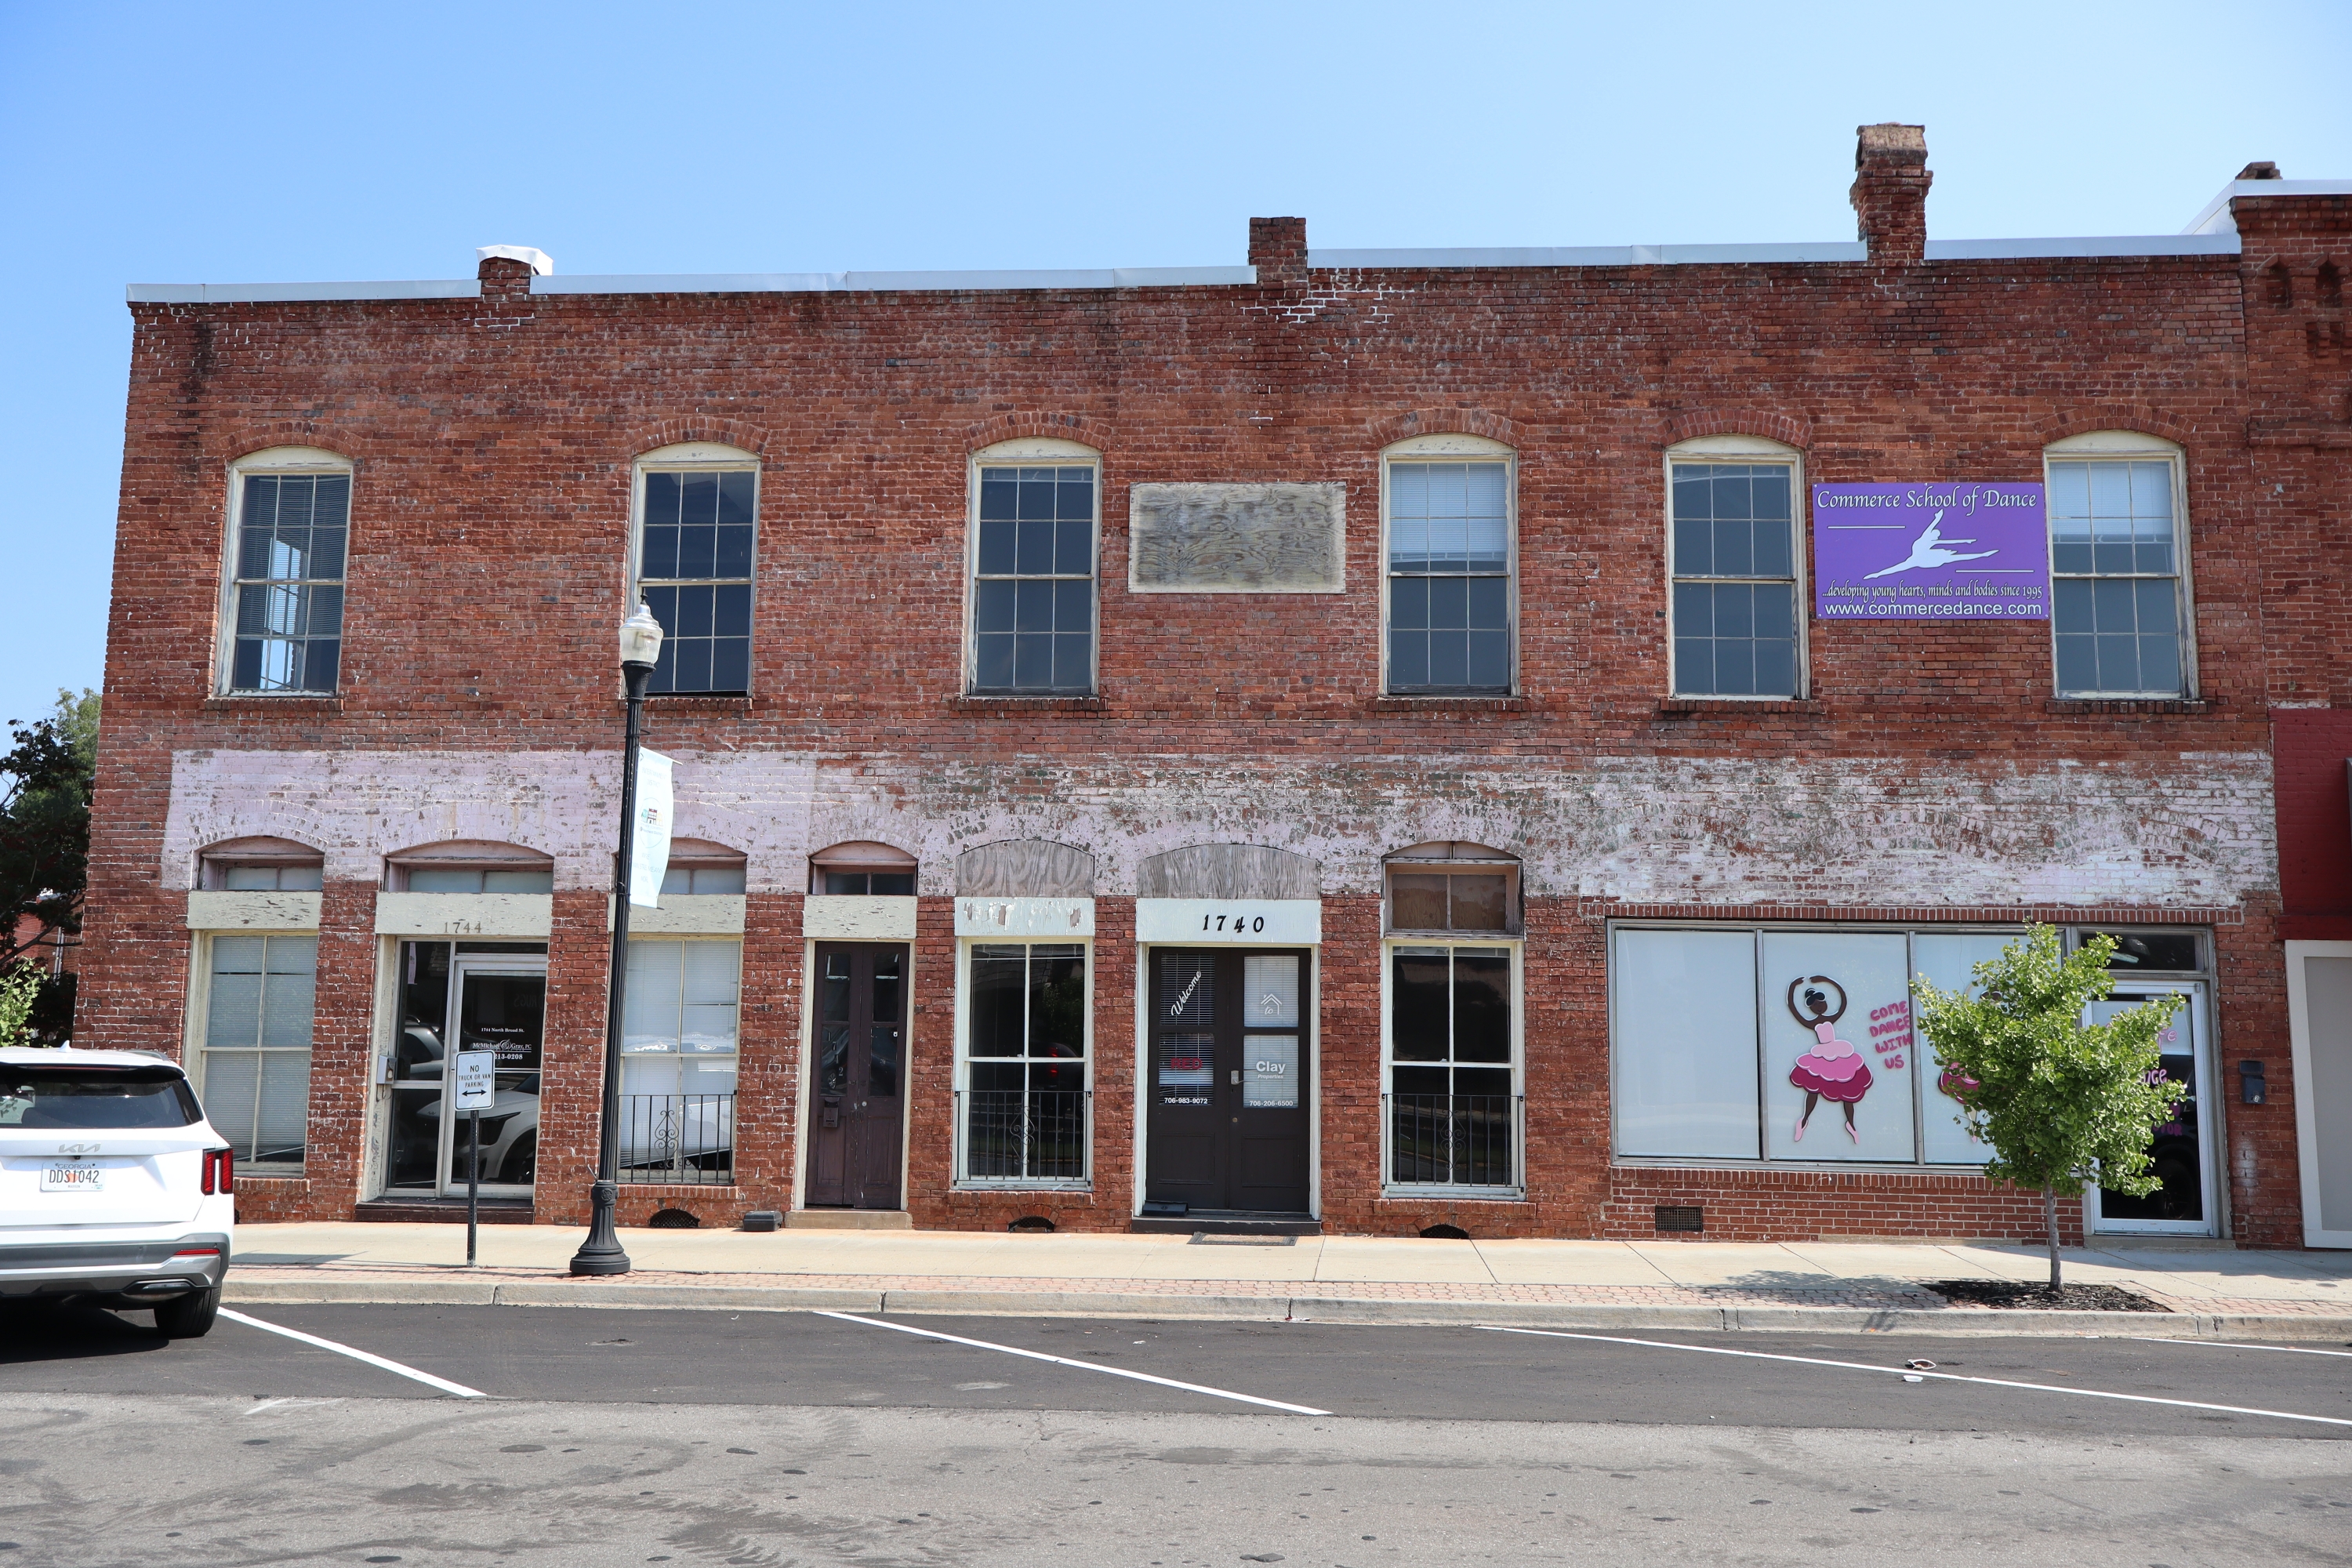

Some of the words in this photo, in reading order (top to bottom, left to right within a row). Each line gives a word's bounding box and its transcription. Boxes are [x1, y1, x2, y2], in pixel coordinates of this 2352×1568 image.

[1817, 490, 1900, 508] Commerce
[1906, 485, 1961, 508] School
[1962, 485, 1981, 517] of
[1982, 489, 2037, 508] Dance
[1822, 579, 1869, 604] ...developing
[1871, 586, 1896, 604] young
[1899, 579, 1926, 600] hearts,
[1928, 579, 1953, 597] minds
[1955, 579, 1973, 597] and
[1973, 579, 1998, 597] bodies
[2000, 583, 2020, 597] since
[2022, 586, 2043, 600] 1995
[1824, 601, 2042, 615] www.commercedance.com
[444, 921, 482, 934] 1744
[1202, 914, 1265, 934] 1740
[1171, 971, 1202, 1016] Welcome
[1264, 1006, 1274, 1014] to
[1870, 1000, 1909, 1022] COME
[1869, 1014, 1911, 1037] DANCE
[1875, 1032, 1913, 1054] WITH
[1171, 1058, 1203, 1070] RED
[1256, 1061, 1286, 1074] Clay
[1884, 1054, 1905, 1069] US
[58, 1142, 102, 1153] KIA
[49, 1169, 100, 1184] DDS1042
